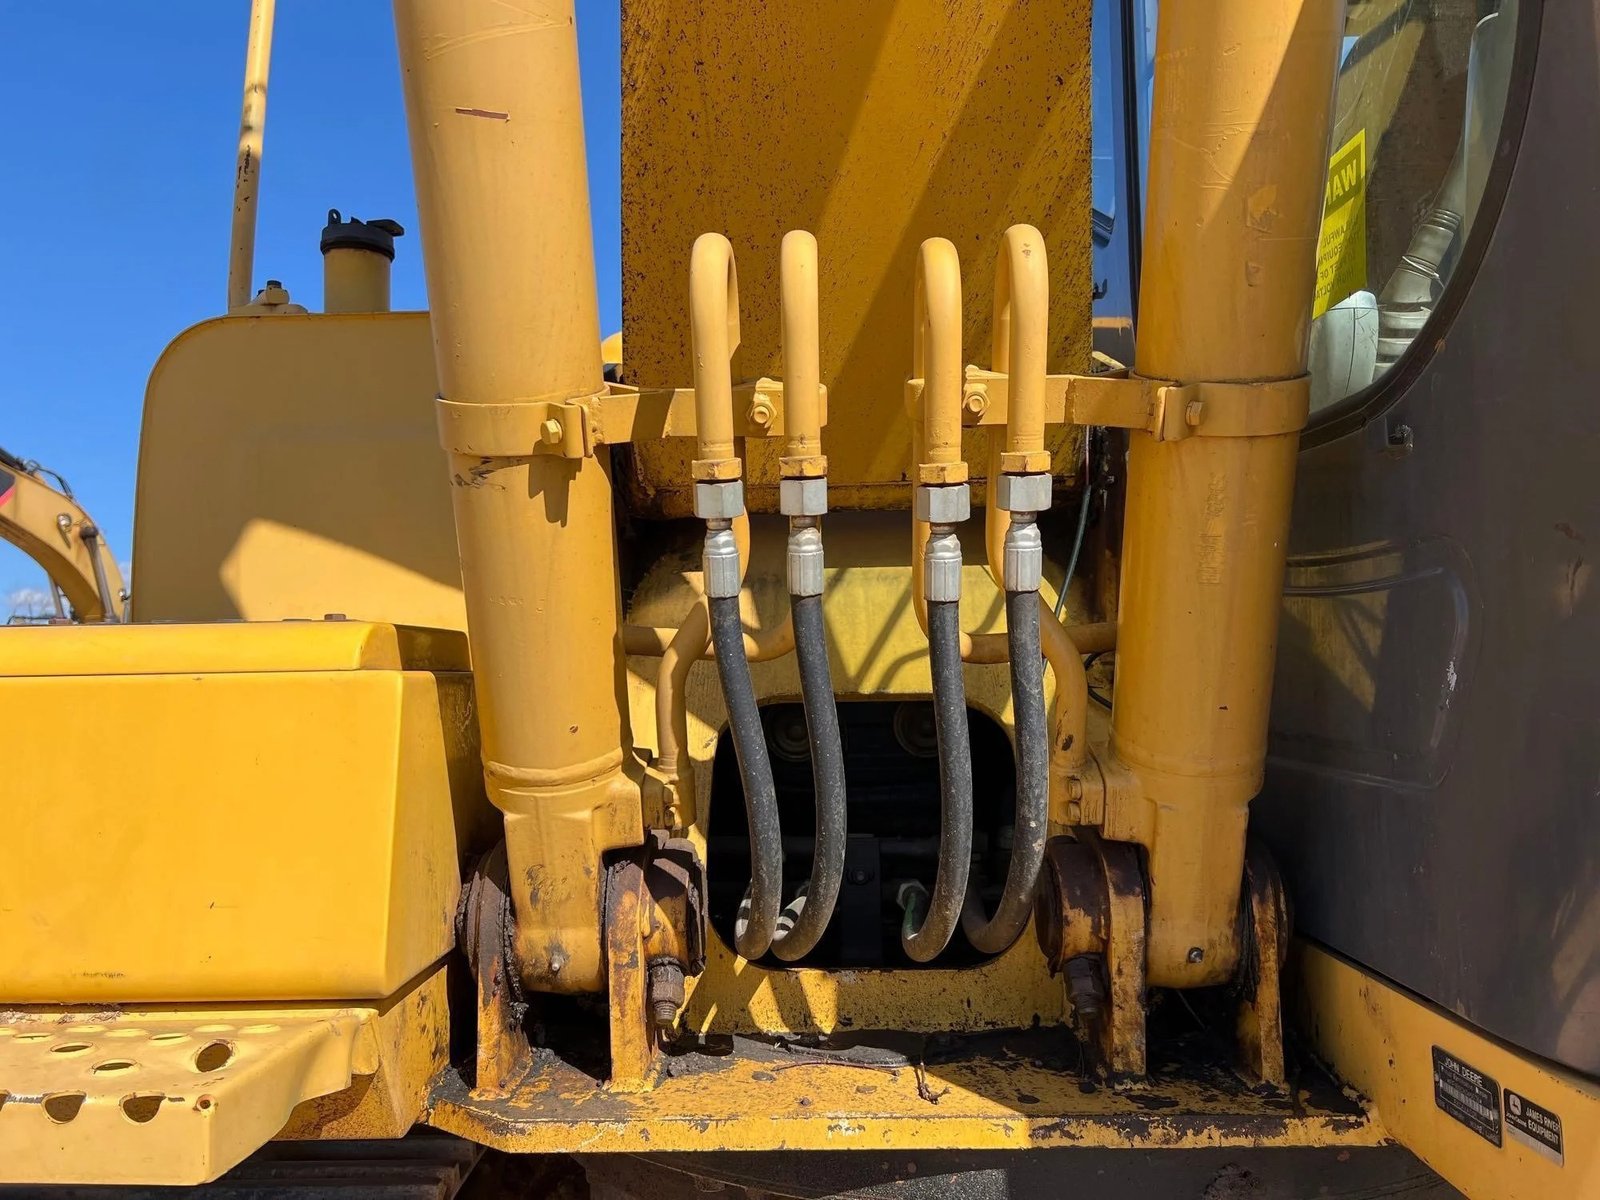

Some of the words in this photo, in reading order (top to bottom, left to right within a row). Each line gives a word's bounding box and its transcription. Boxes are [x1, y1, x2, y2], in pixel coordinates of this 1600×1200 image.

[1444, 1057, 1460, 1073] JOHN
[1461, 1066, 1483, 1087] DEERE
[1525, 1107, 1543, 1124] JAMES
[1528, 1119, 1559, 1145] EQUIPMENT
